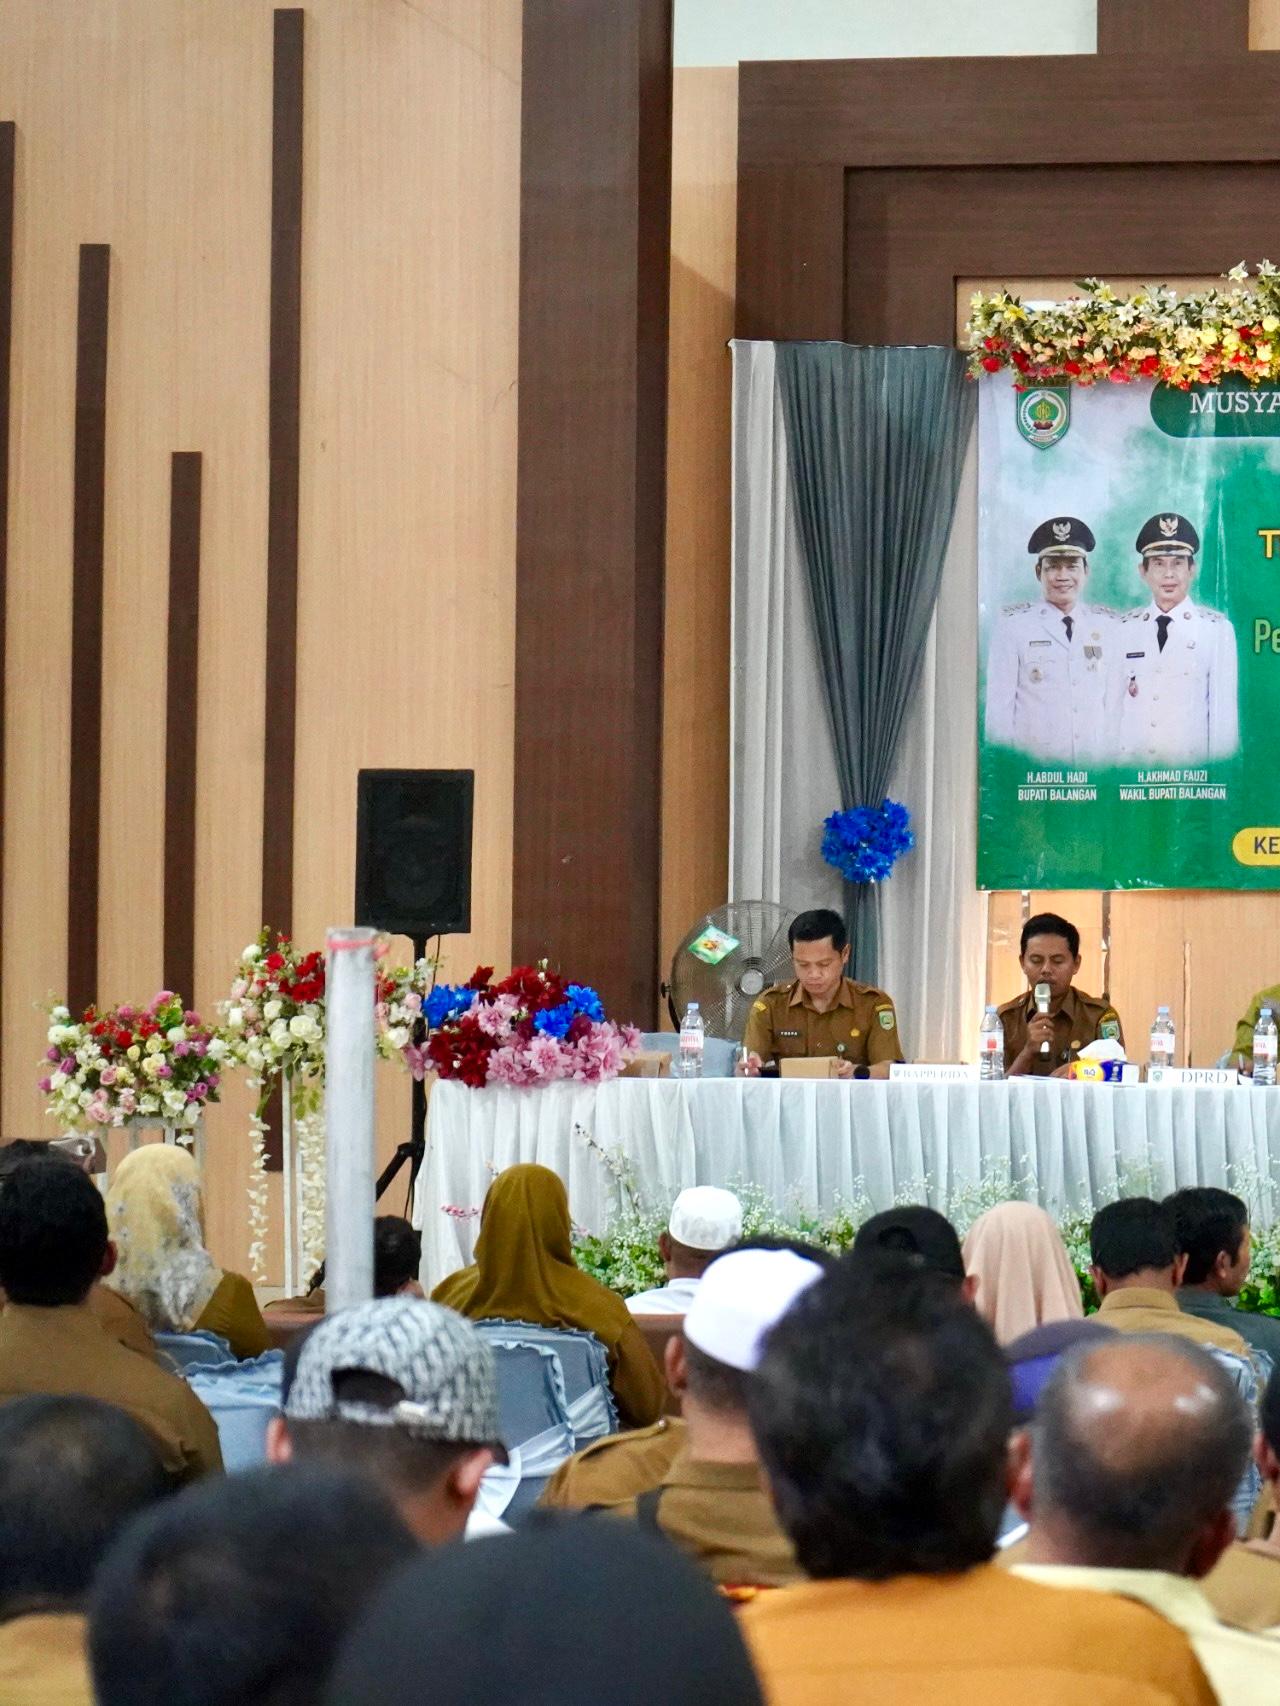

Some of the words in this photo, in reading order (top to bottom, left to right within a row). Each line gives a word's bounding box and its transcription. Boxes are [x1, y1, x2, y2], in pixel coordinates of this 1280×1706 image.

[1027, 771, 1064, 784] H.ABDUL
[1067, 771, 1088, 784] HADI
[1137, 770, 1181, 783] H.AKHMAD
[1183, 770, 1208, 782] FAUZI
[1018, 788, 1048, 801] BUPATI
[1050, 788, 1097, 801] BALANGAN
[1120, 788, 1147, 801] WAKIL
[1149, 788, 1177, 801] BUPATI
[1179, 787, 1226, 800] BALANGAN
[1181, 1071, 1229, 1084] DPRD
